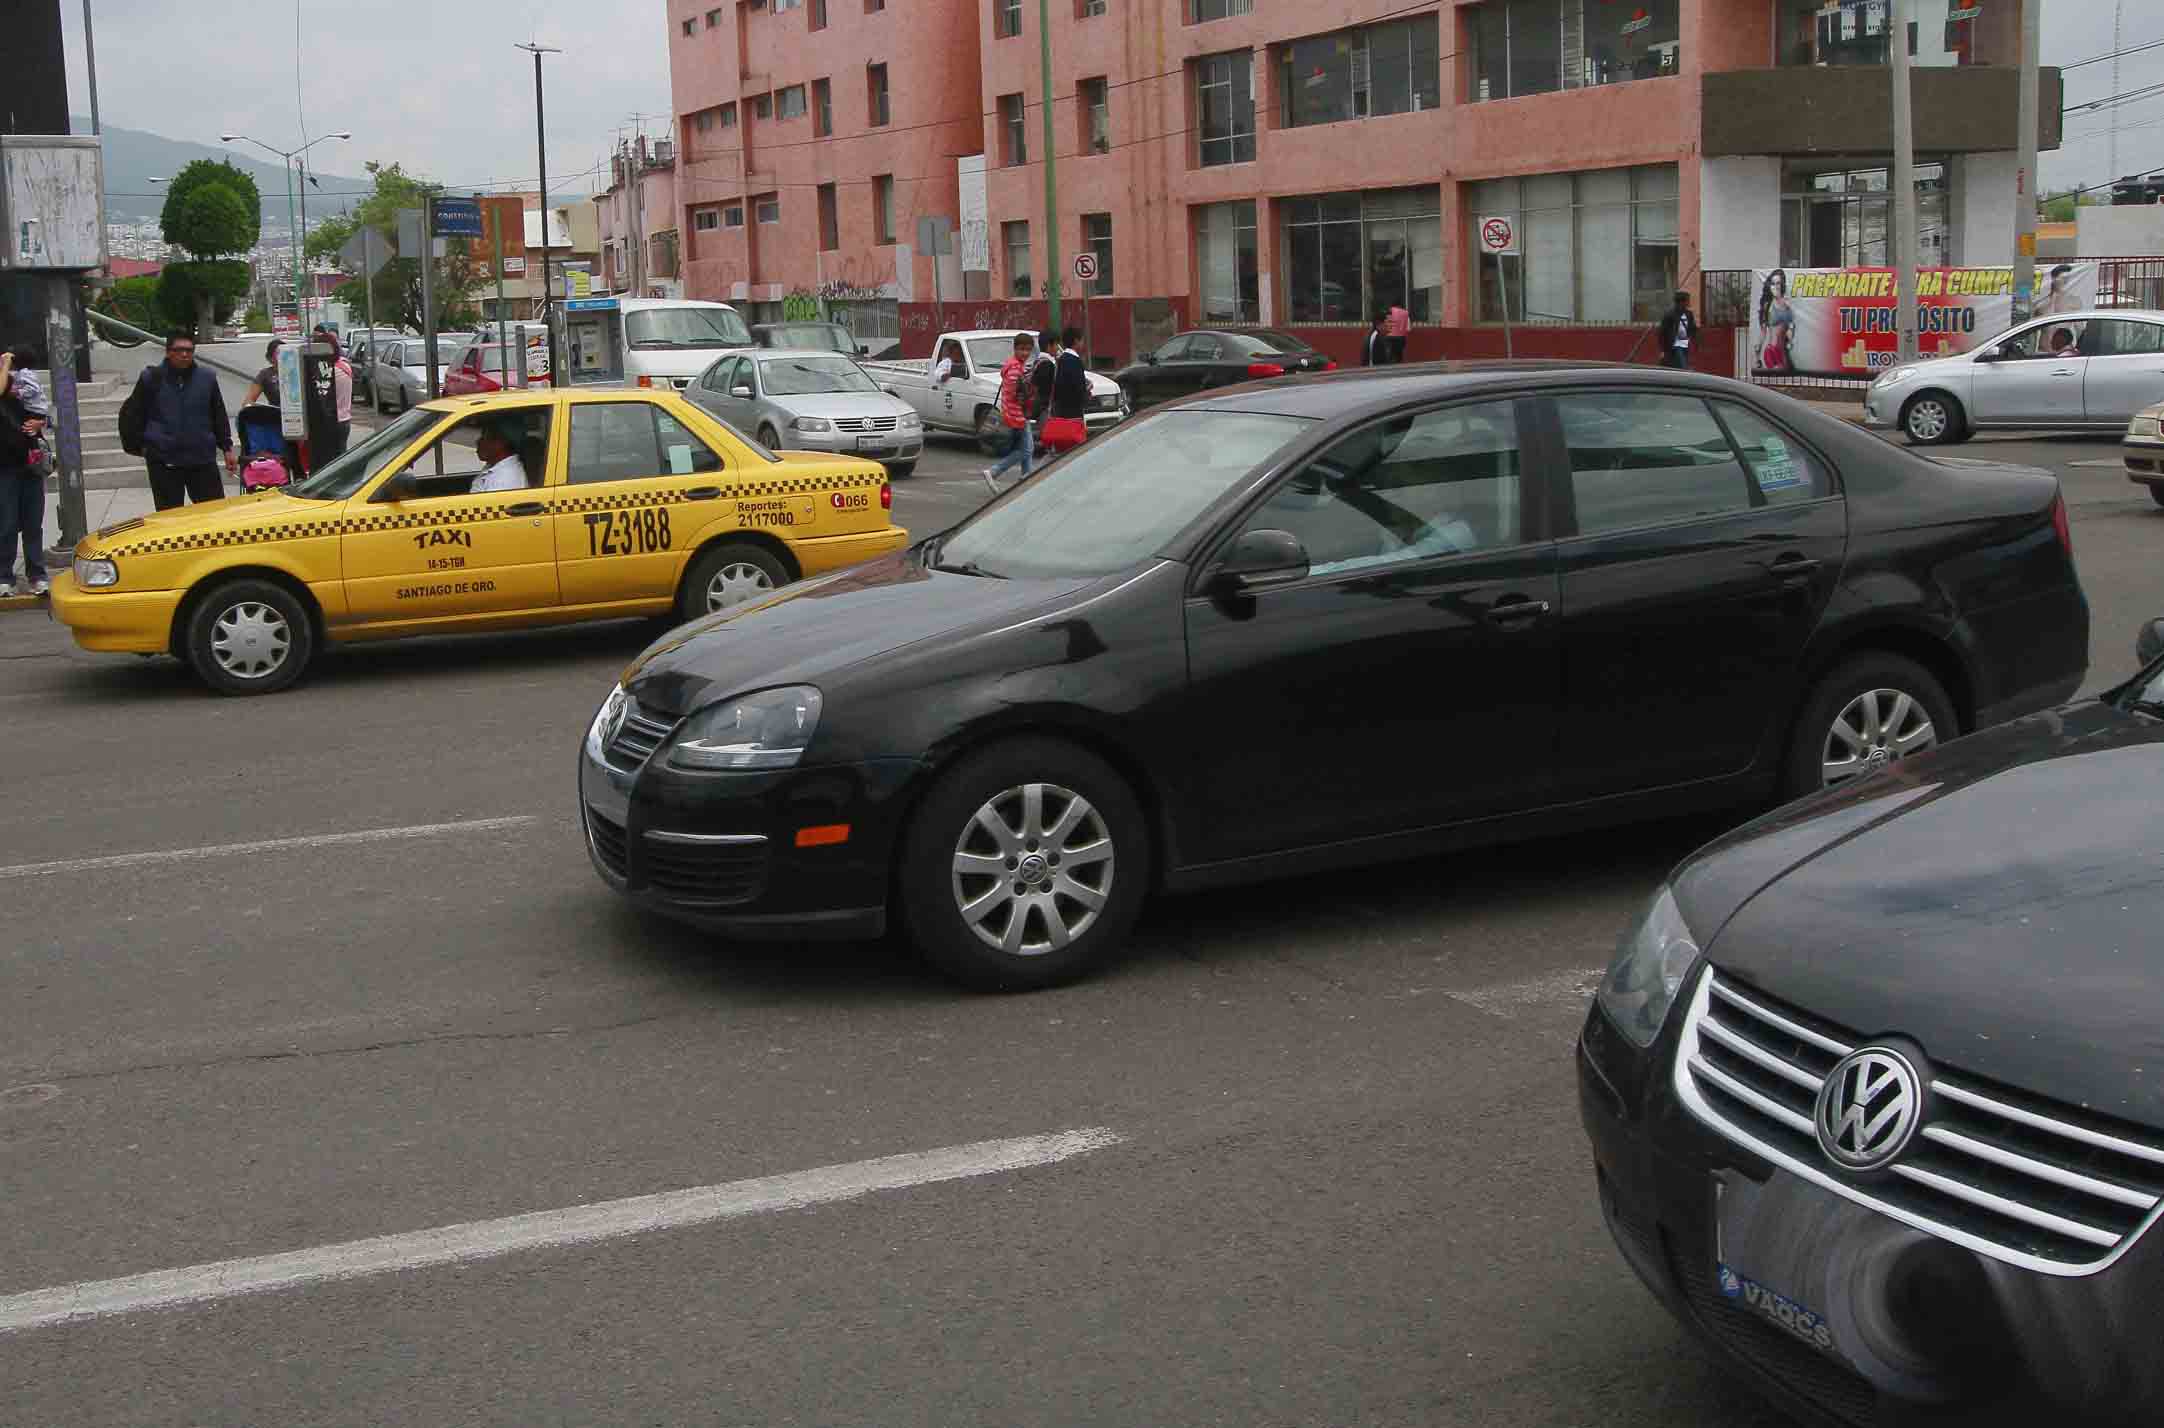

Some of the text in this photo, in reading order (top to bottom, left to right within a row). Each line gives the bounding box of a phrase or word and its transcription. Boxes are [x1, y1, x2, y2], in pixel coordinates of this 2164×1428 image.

[1791, 272, 1892, 297] PREPARATE
[1839, 302, 1975, 333] TU PROÓSITO
[738, 500, 787, 512] Reportes:
[846, 495, 868, 507] 066
[738, 512, 794, 527] 2117000
[413, 529, 472, 549] TAXI
[584, 507, 672, 555] TZ-3188
[396, 584, 452, 600] SANTIAGO
[454, 582, 470, 594] DE
